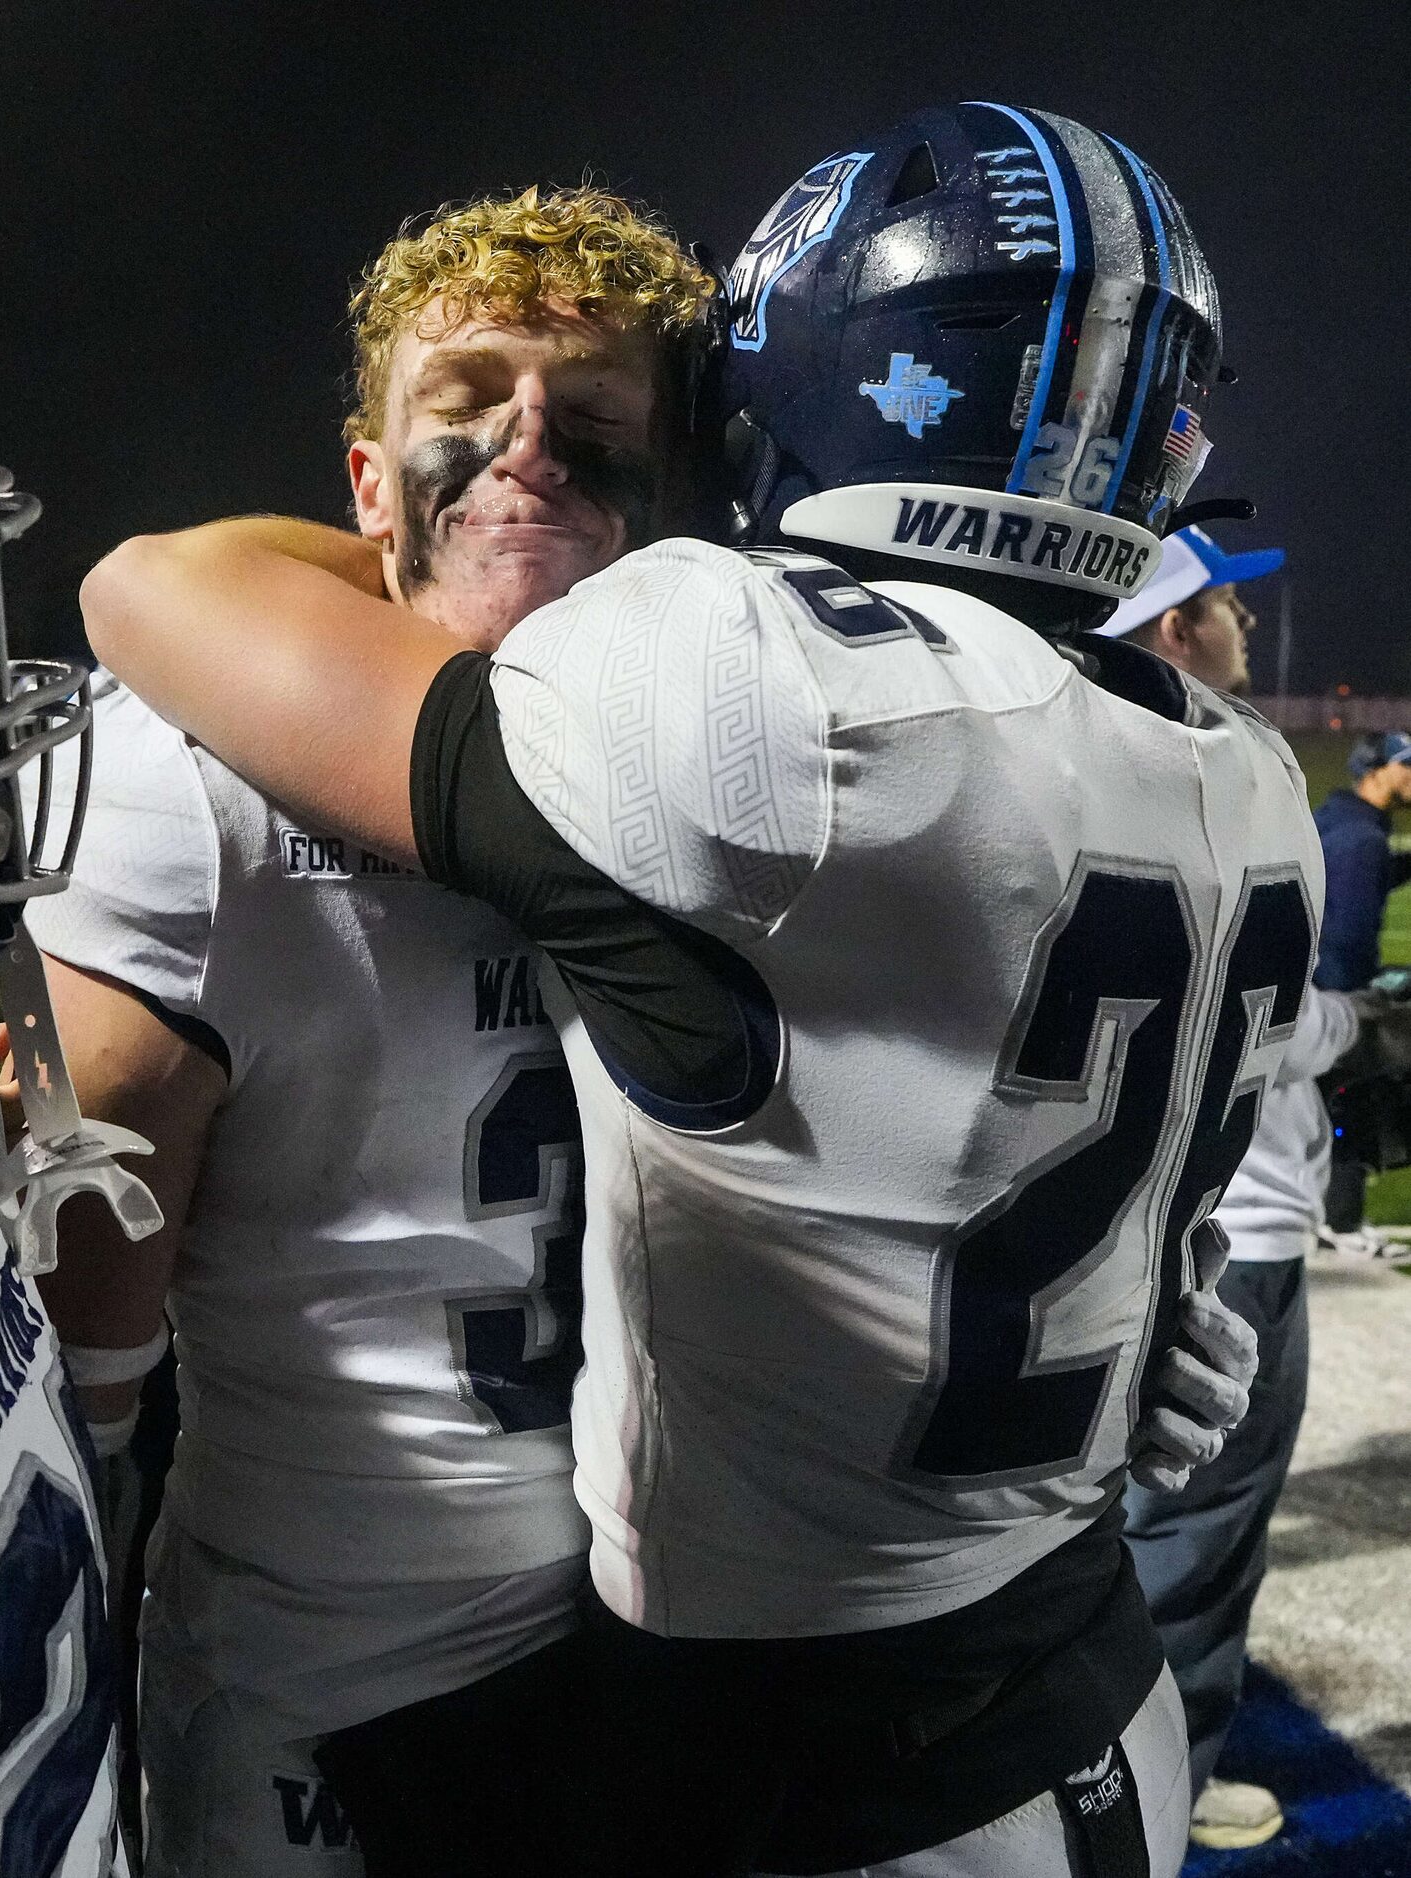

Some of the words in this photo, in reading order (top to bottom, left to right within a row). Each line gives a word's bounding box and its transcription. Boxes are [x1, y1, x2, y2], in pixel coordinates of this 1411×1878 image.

[1021, 421, 1120, 505] 26
[891, 497, 1151, 589] WARRIORS
[288, 836, 347, 872] FOR
[888, 849, 1317, 1493] 26
